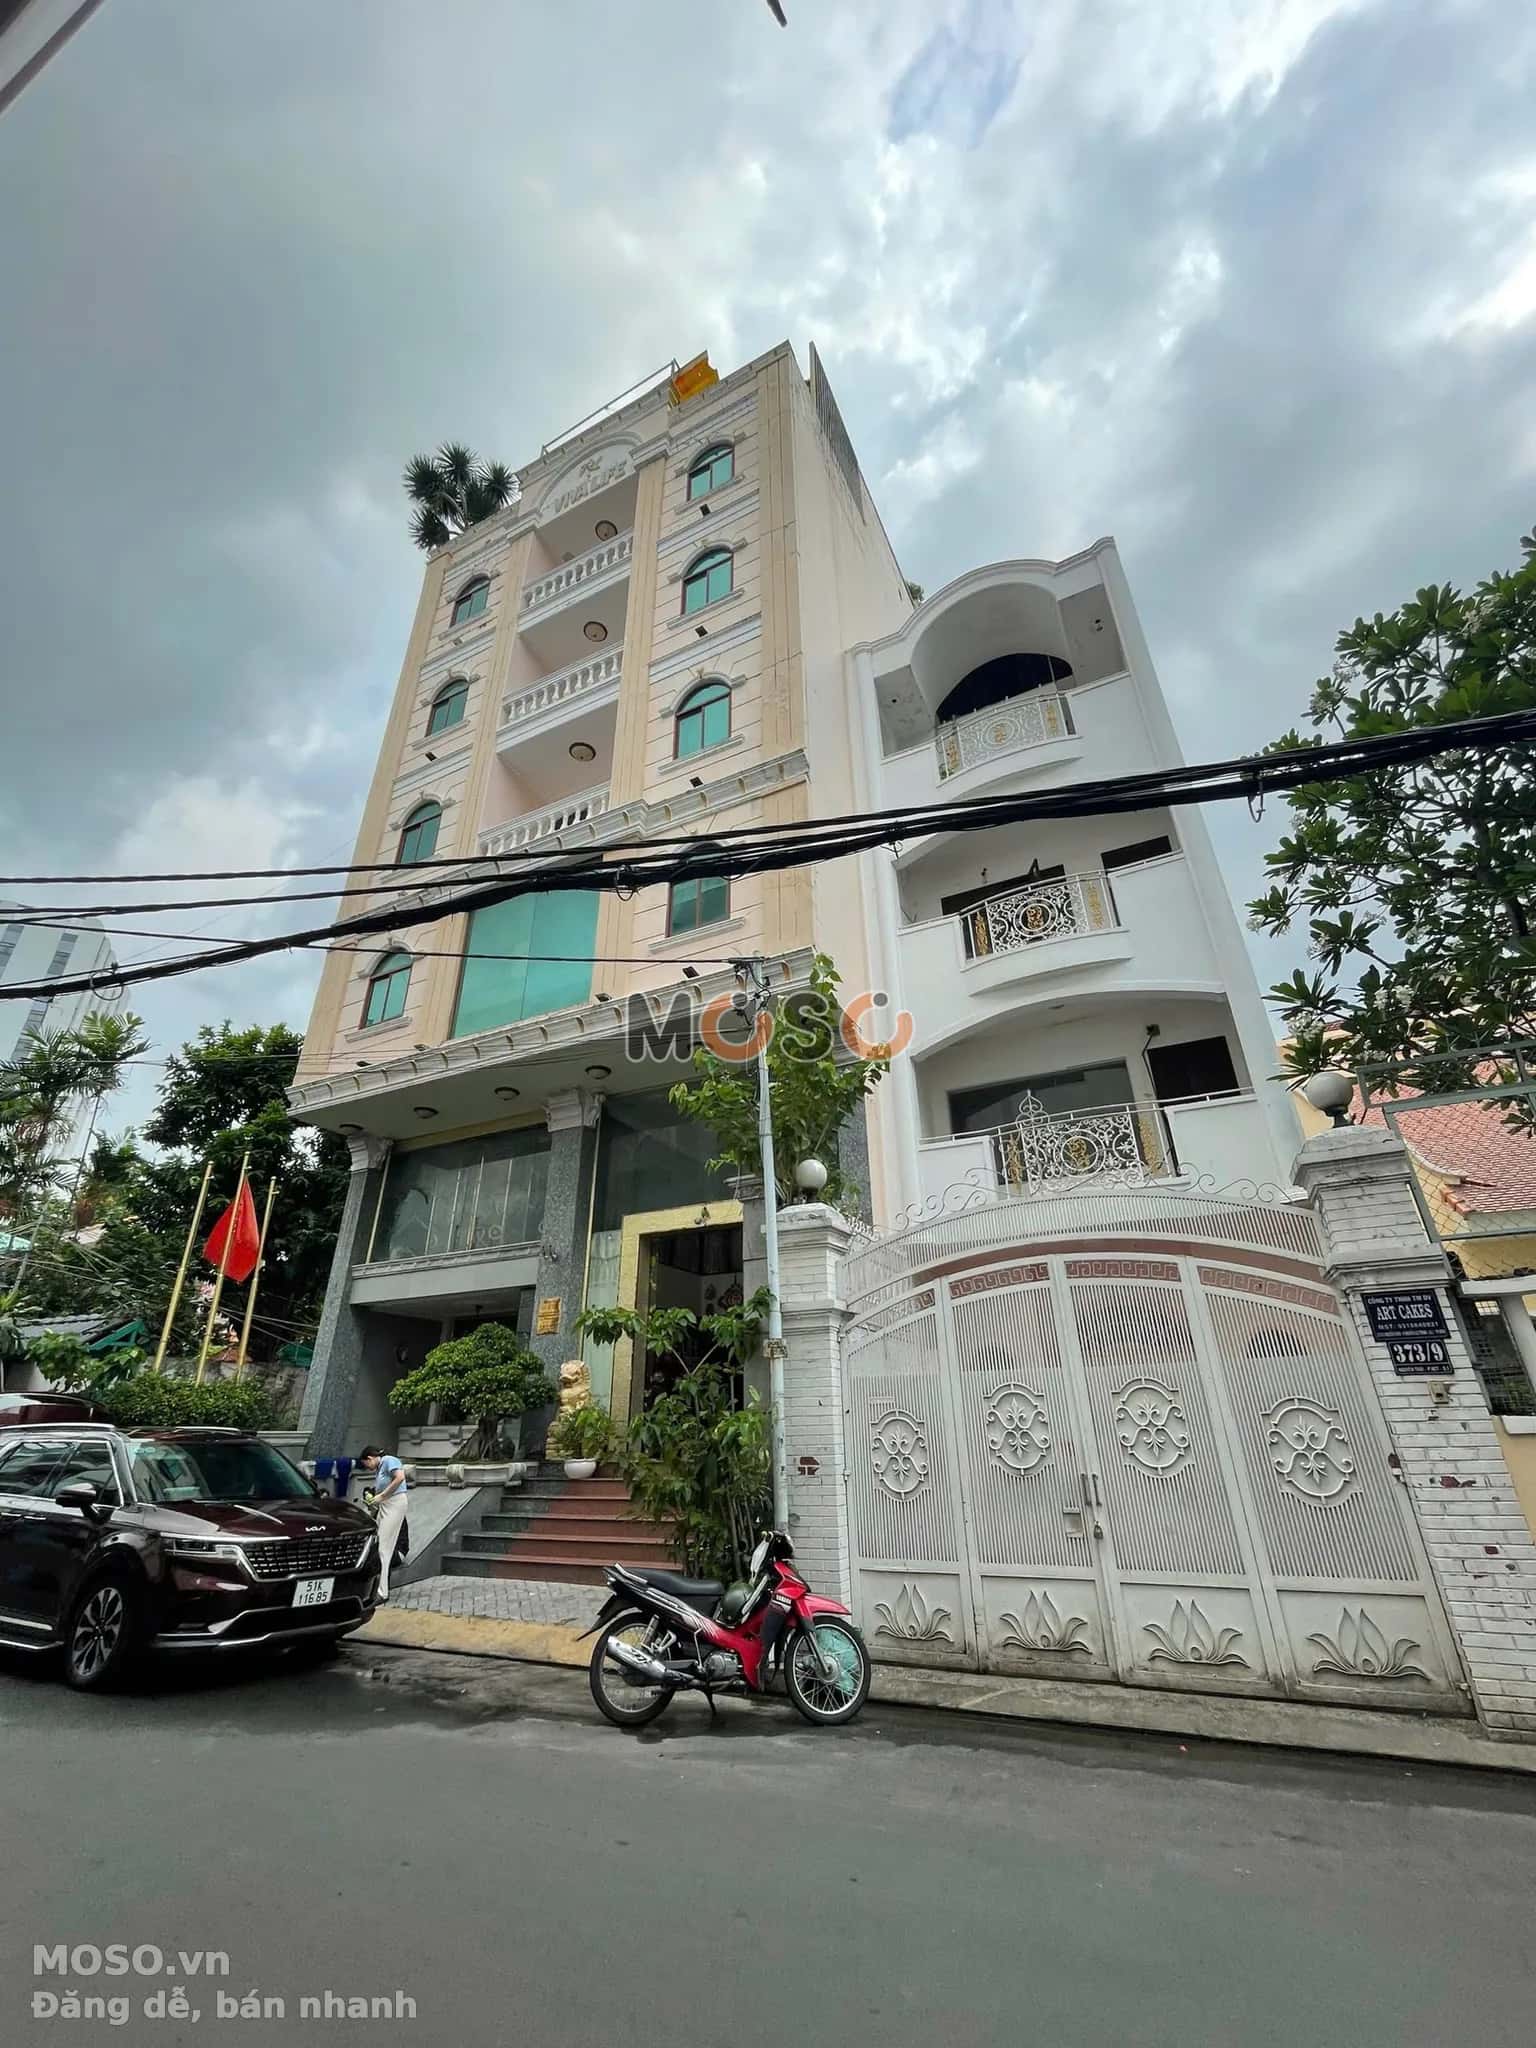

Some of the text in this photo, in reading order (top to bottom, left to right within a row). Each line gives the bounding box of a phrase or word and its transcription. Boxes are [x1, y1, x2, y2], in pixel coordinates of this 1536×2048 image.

[1376, 1304, 1433, 1320] ART CAKES
[1393, 1342, 1443, 1363] 373/9
[306, 1581, 323, 1593] 51K
